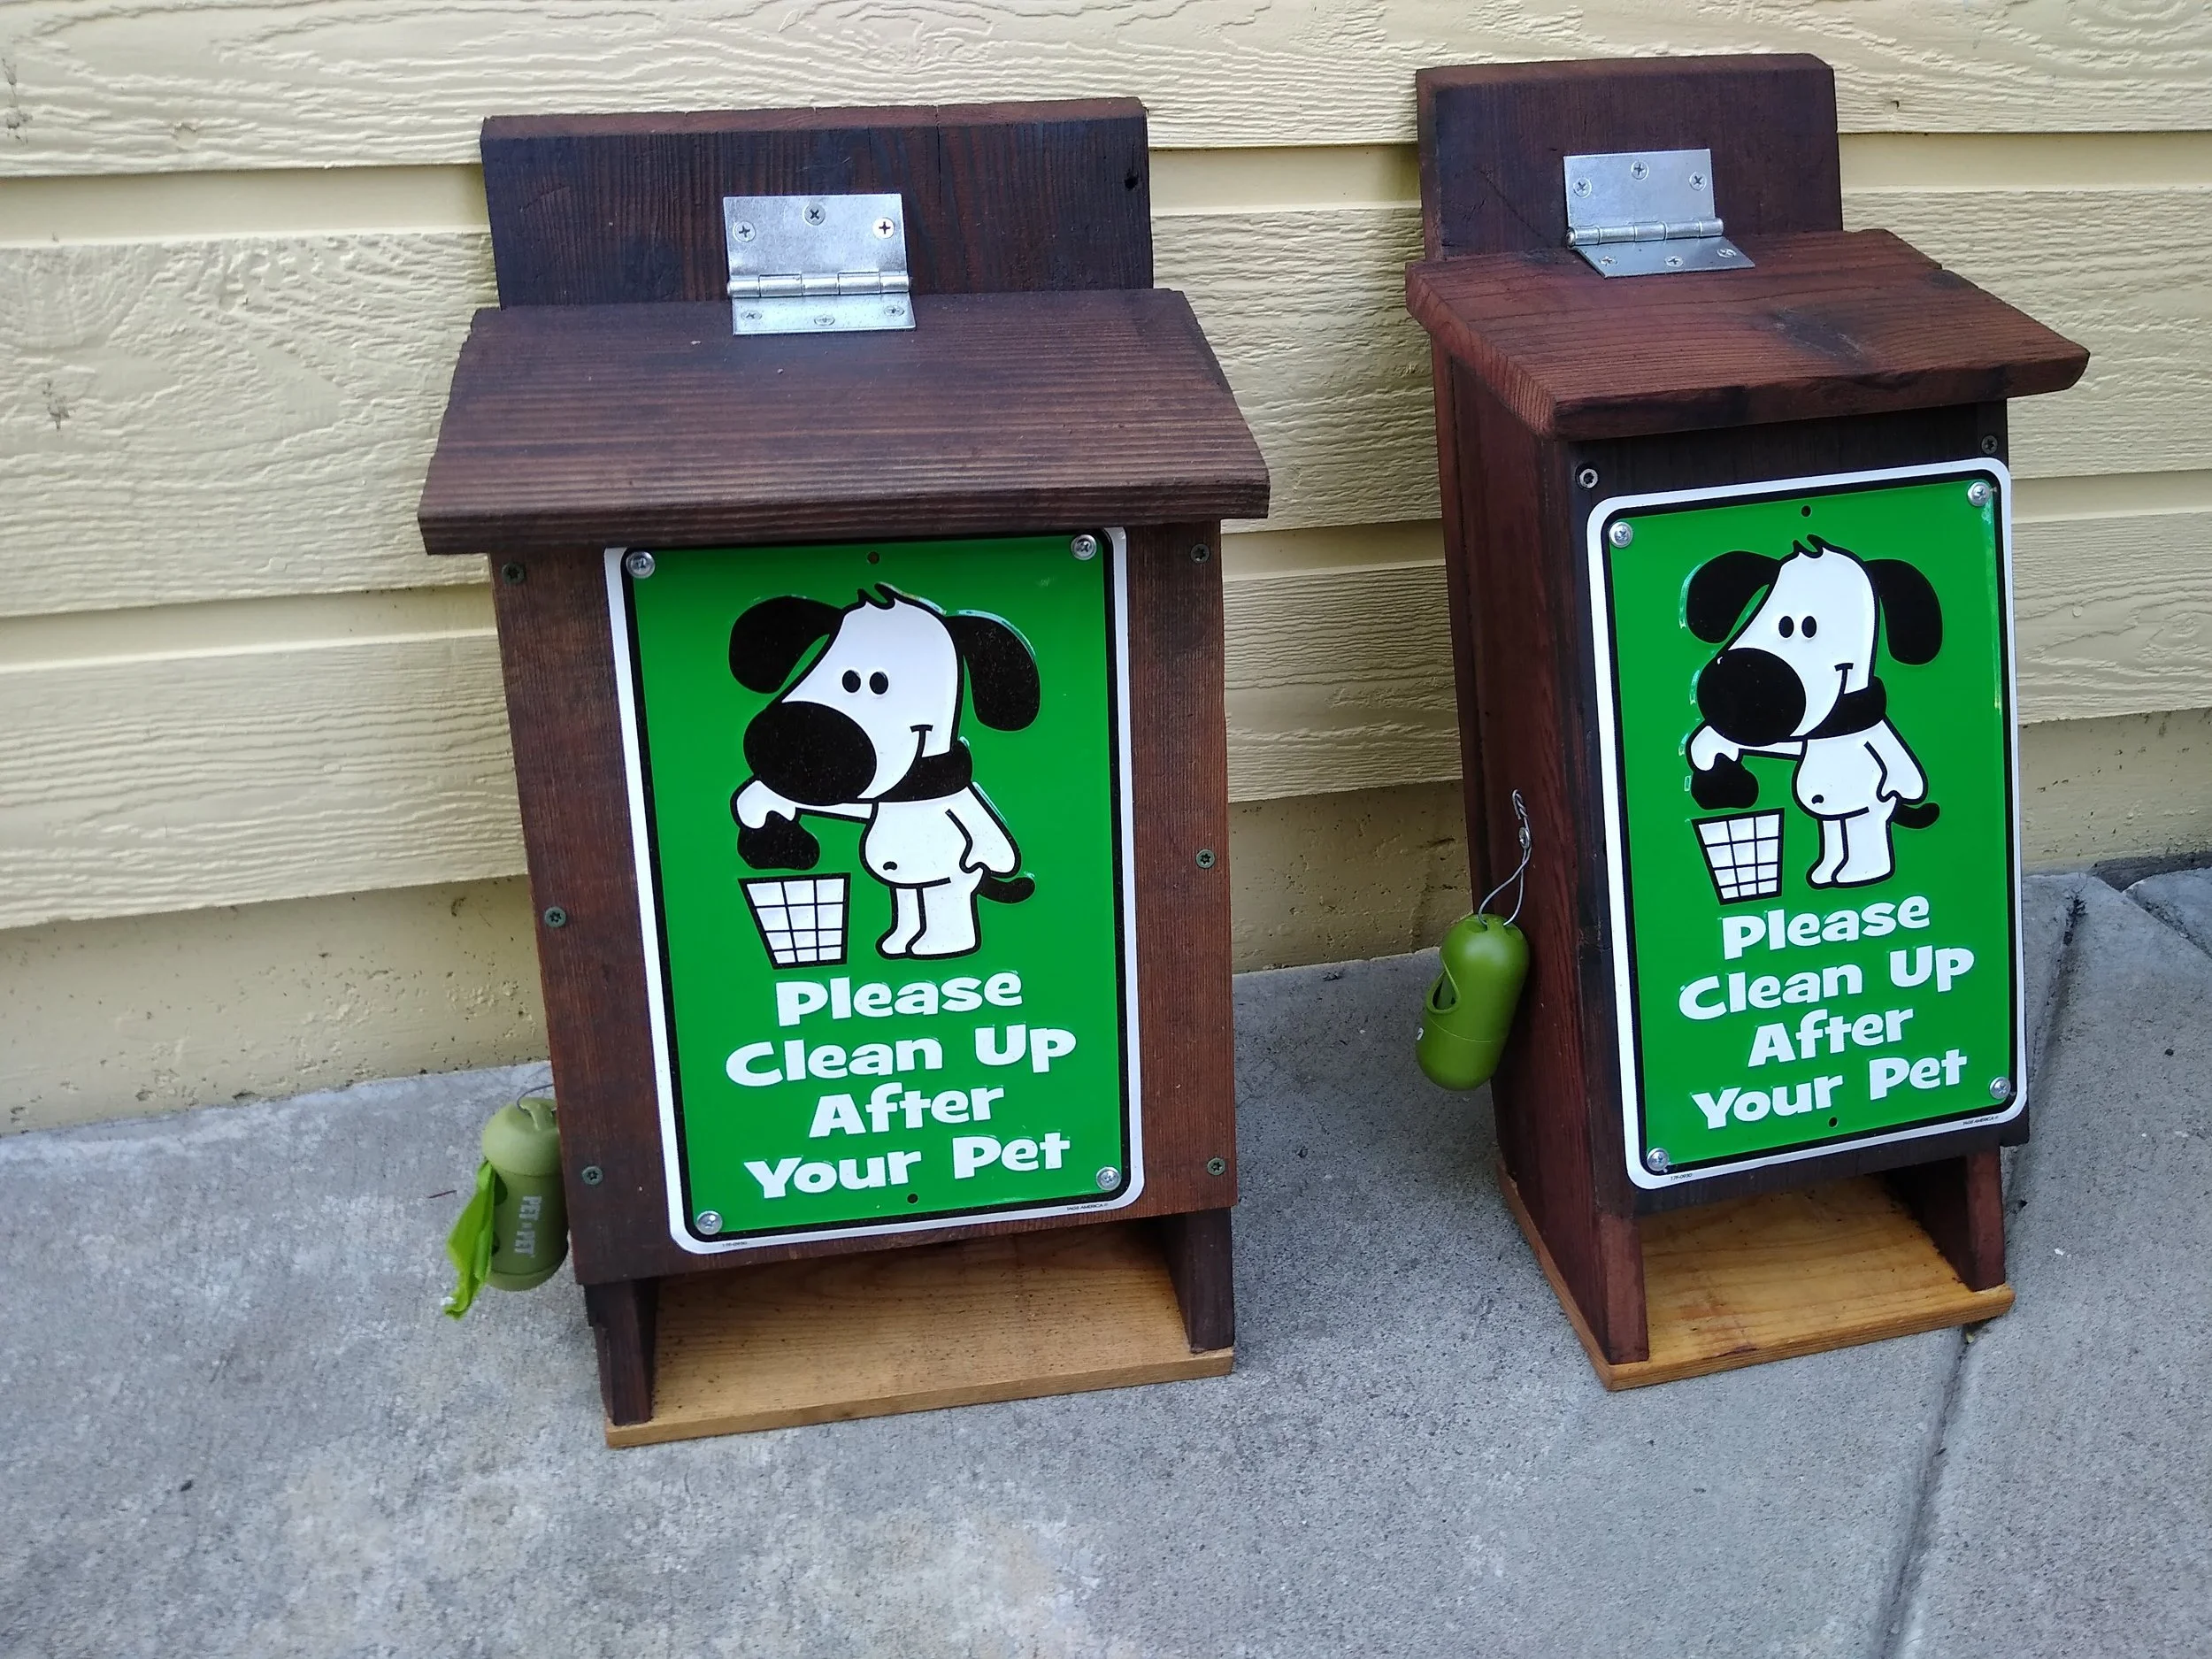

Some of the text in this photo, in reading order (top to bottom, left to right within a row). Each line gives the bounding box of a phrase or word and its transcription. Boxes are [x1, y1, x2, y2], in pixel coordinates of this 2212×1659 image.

[1722, 895, 1931, 960] Please
[775, 972, 1023, 1027] Please
[1678, 945, 1975, 1020] Clean Up
[726, 1024, 1077, 1087] Clean Up
[1747, 1008, 1914, 1068] After
[809, 1082, 1004, 1138] After
[1691, 1048, 1968, 1130] Your Pet
[743, 1132, 1071, 1199] Your Pet
